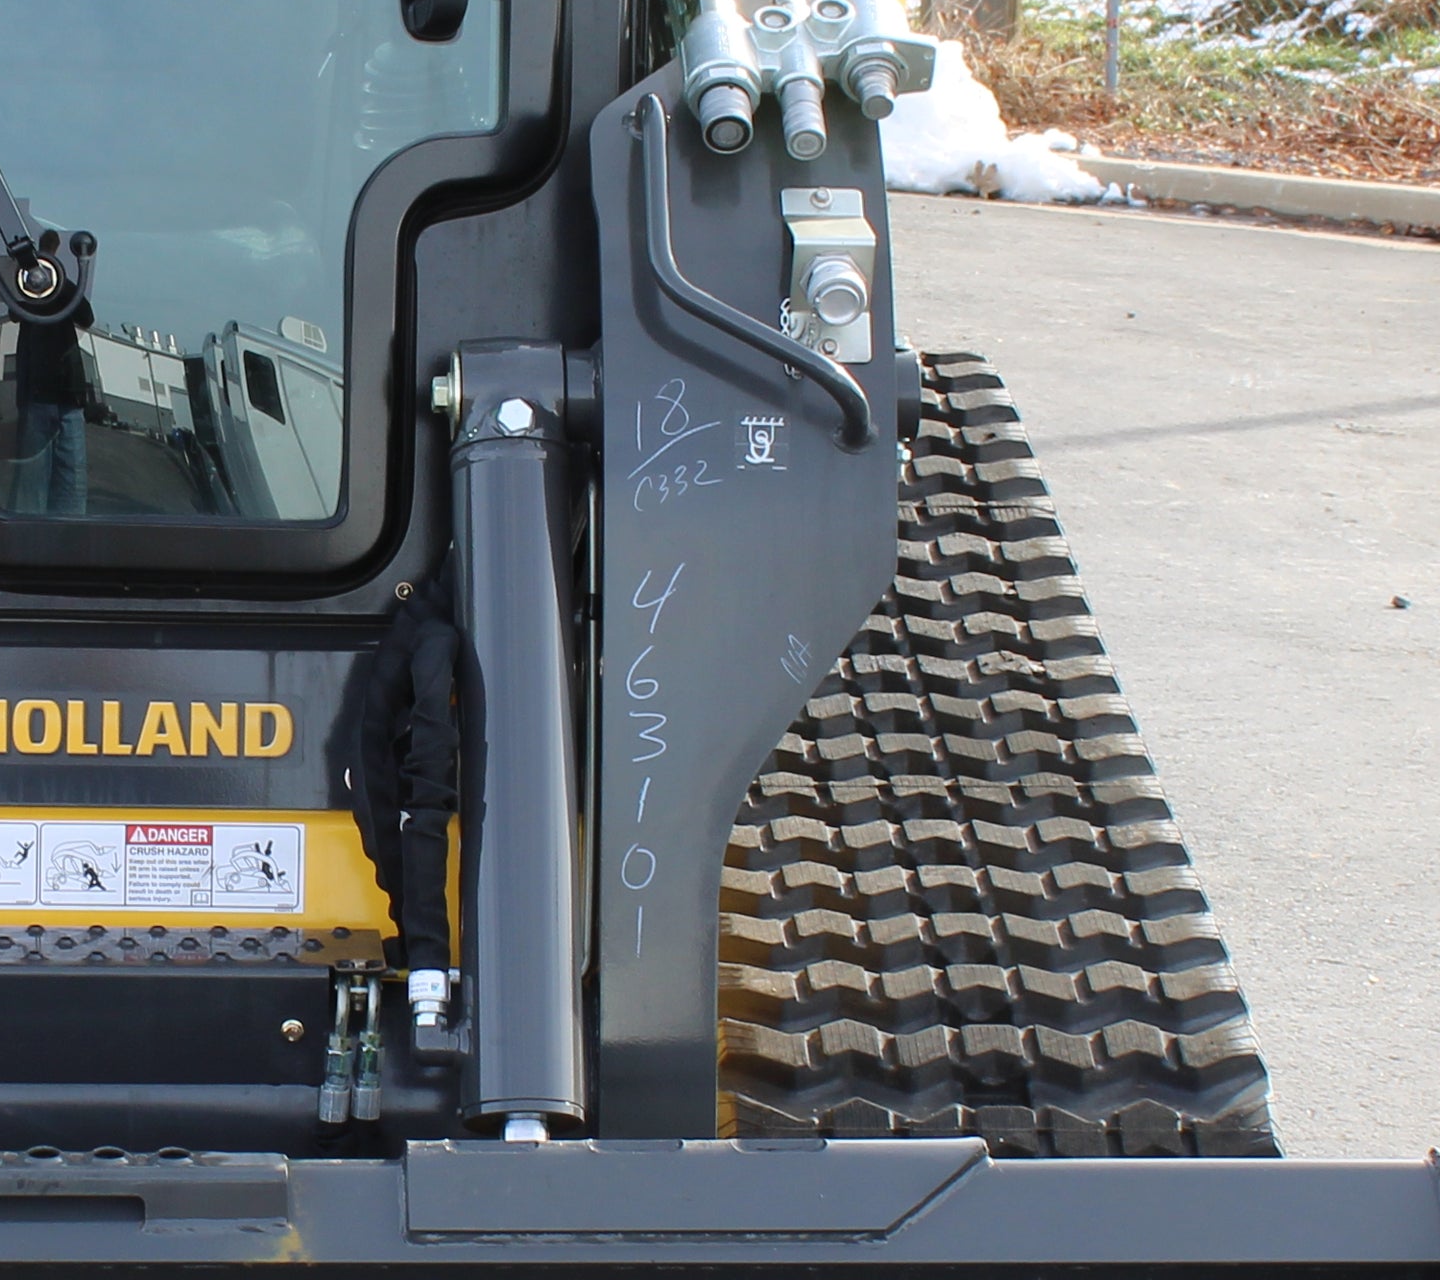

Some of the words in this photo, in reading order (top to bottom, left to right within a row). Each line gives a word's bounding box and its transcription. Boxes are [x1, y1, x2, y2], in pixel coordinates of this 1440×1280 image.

[148, 828, 208, 843] DANGER
[129, 847, 165, 856] CRUSH
[167, 848, 209, 857] HAZARD
